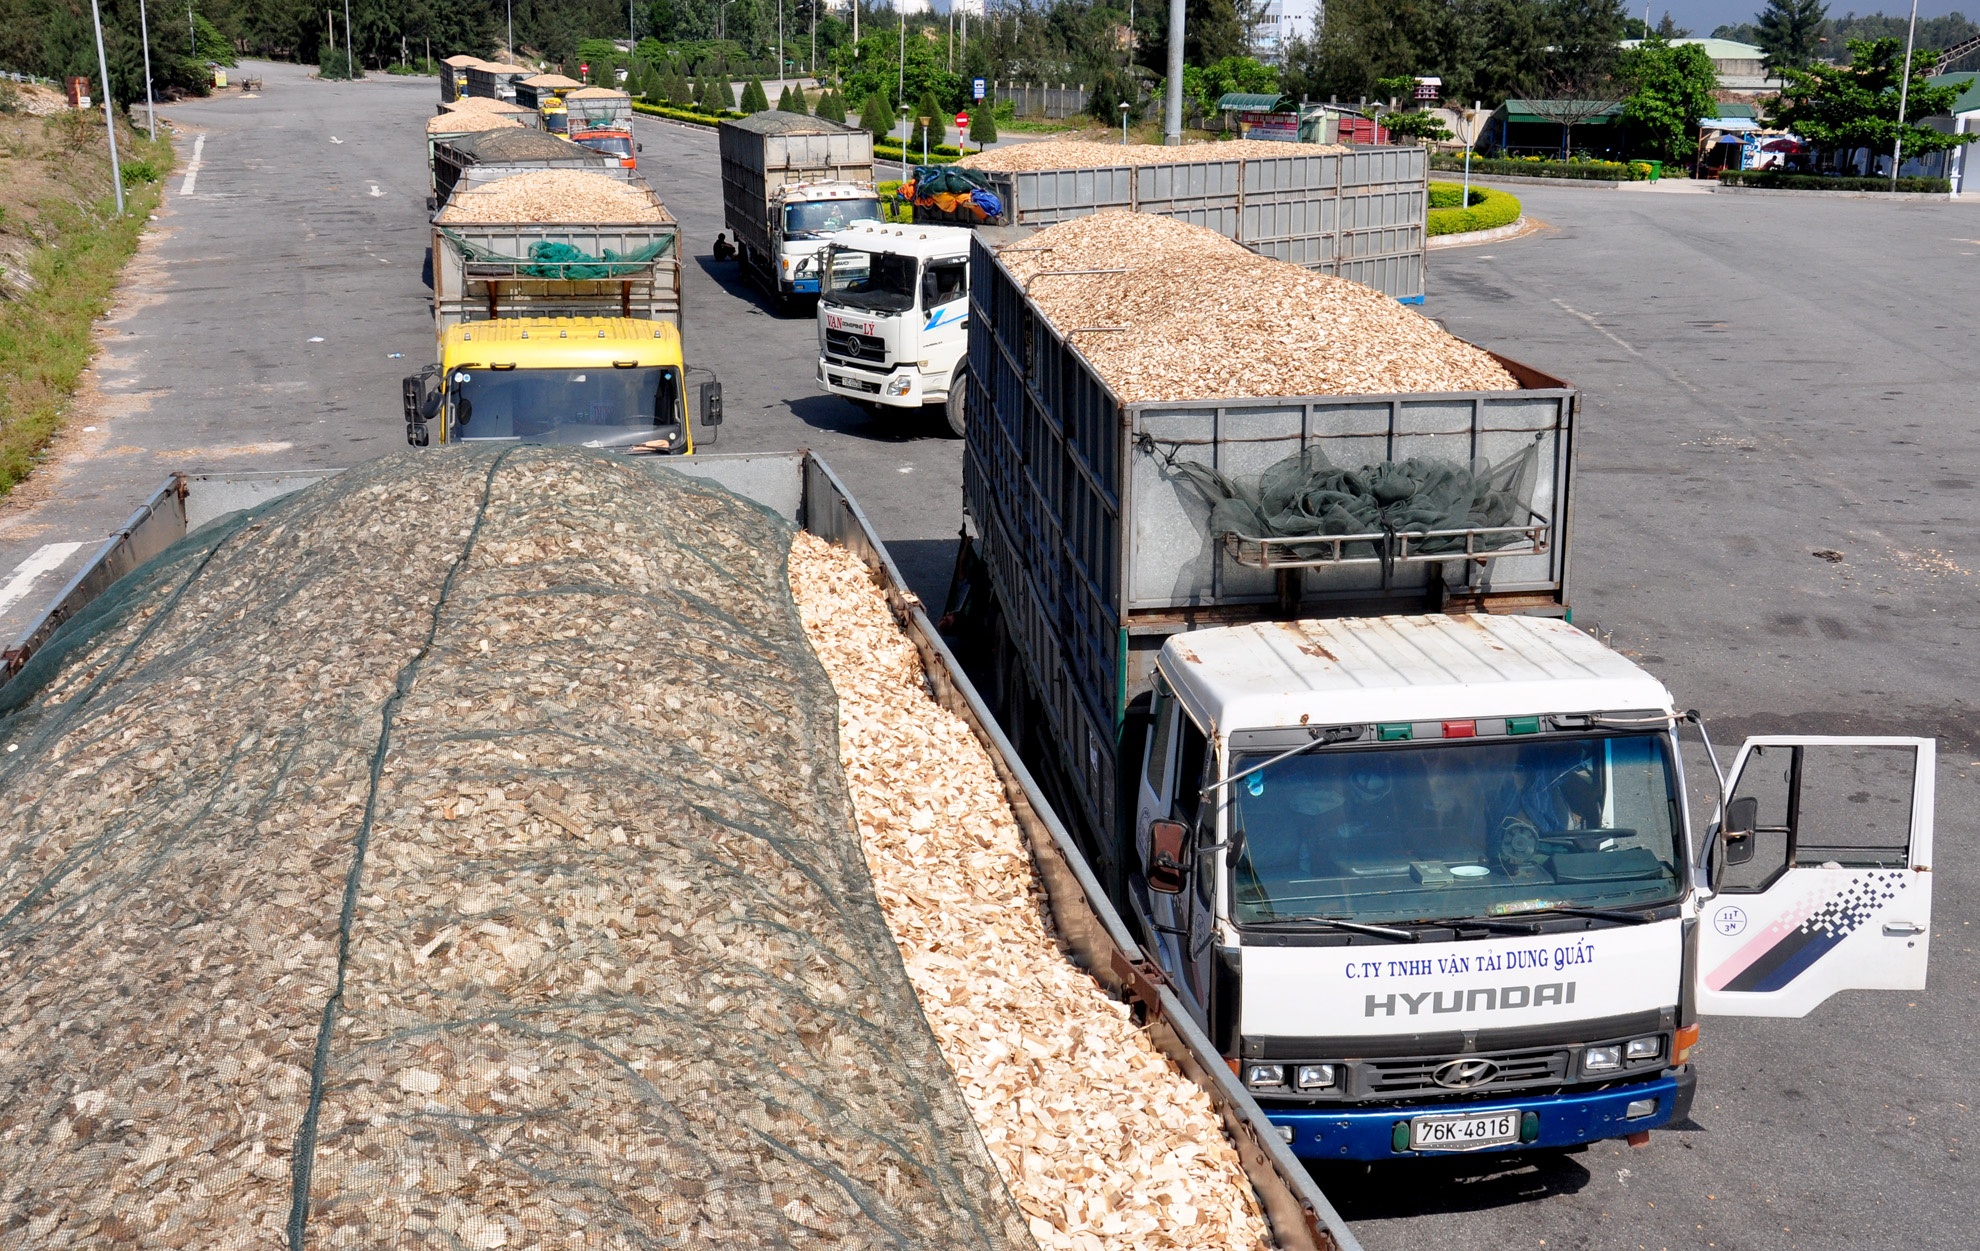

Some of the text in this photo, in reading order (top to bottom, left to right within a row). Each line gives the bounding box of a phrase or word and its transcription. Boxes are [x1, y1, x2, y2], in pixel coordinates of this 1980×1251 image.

[1345, 936, 1595, 979] C.TY TNHH VẬN TẢI DUNG QUẤT
[1364, 981, 1577, 1018] HYUNDAI
[1422, 1119, 1510, 1141] 76K-4816
